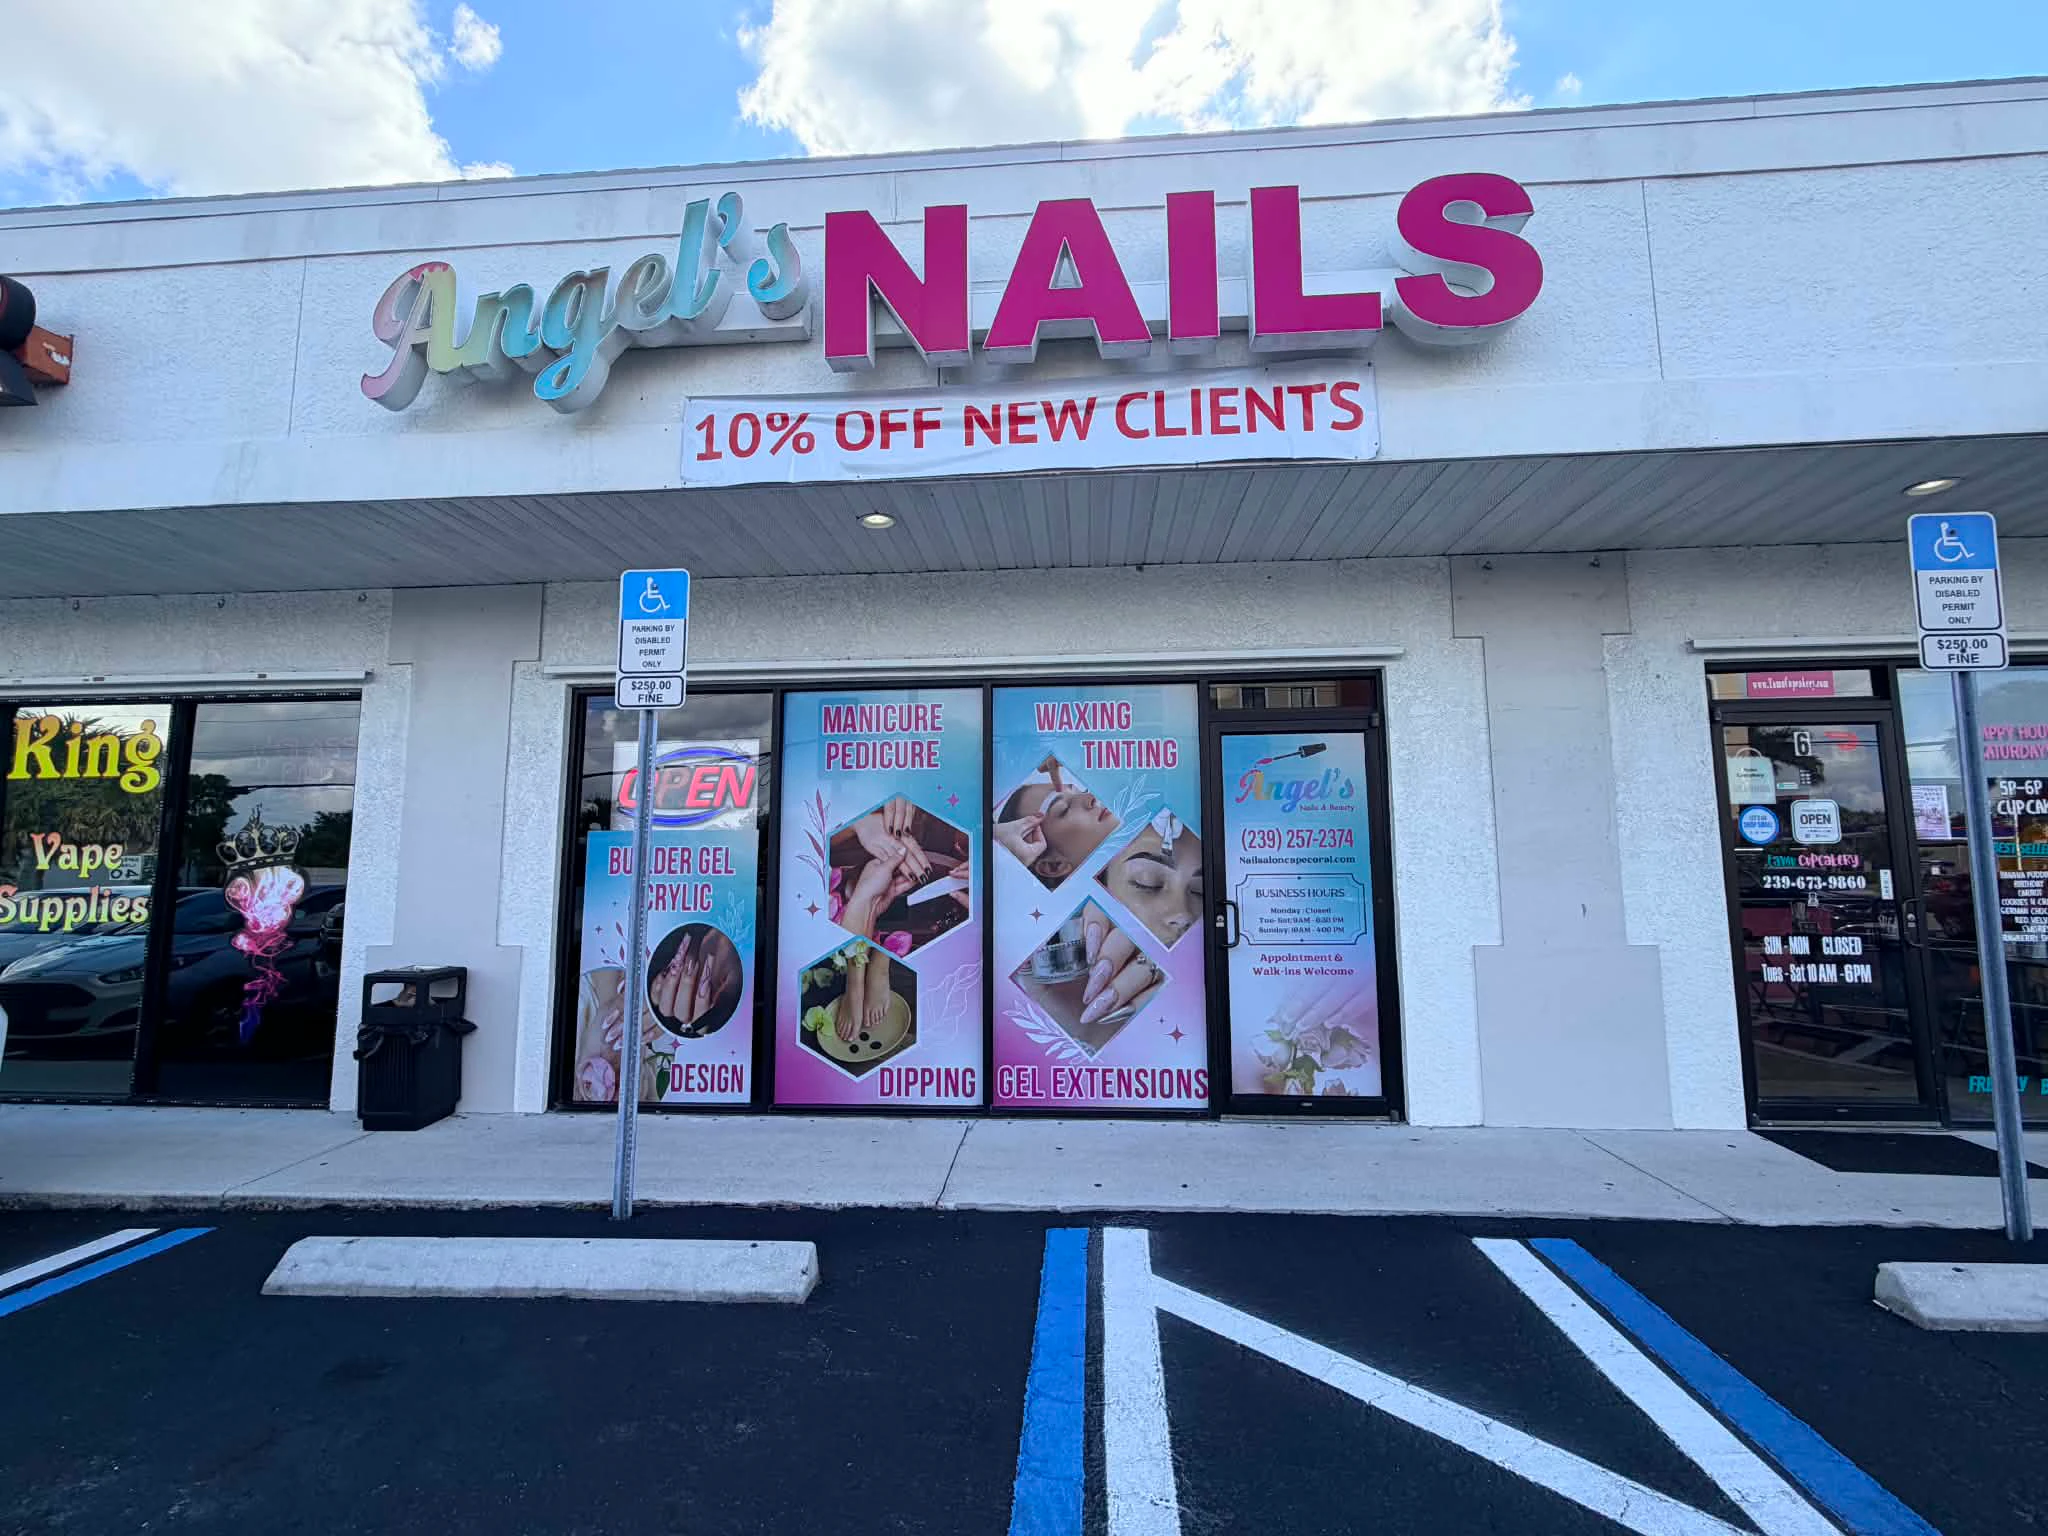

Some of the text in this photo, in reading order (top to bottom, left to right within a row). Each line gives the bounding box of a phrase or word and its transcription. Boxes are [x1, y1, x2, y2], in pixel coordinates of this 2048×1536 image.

[360, 172, 1544, 401] Angel's NAILS
[695, 381, 1364, 461] 10% OFF NEW CLIENTS
[1929, 575, 1984, 585] PARKING BY
[1935, 589, 1980, 598] DISABLED
[1942, 602, 1976, 611] PERMIT
[632, 624, 675, 634] PARKING BY
[1948, 616, 1972, 625] ONLY
[634, 636, 671, 644] DISABLED
[1937, 638, 1988, 650] $250.00
[639, 648, 666, 657] PERMIT
[1948, 653, 1980, 664] FINE
[631, 680, 672, 691] $250.00
[638, 693, 663, 703] FINE
[822, 702, 945, 736] MANICURE
[1035, 701, 1132, 732] WAXING
[1983, 726, 2014, 741] APPY
[7, 714, 164, 793] King
[1081, 738, 1179, 769] TINTING
[1796, 732, 1810, 756] 6
[825, 740, 942, 771] PEDICURE
[618, 765, 756, 808] OPEN
[1235, 767, 1355, 813] Angel's
[1800, 813, 1832, 825] OPEN
[1241, 827, 1355, 852] (239) 257-2374
[30, 832, 124, 878] Vape
[608, 846, 737, 876] BUDER GEL
[1239, 855, 1356, 866] Nailsaloncapecoral.com
[1763, 875, 1866, 890] 239-673-9860
[647, 882, 713, 912] CRYLIC
[1255, 888, 1345, 898] BUSINESS HOURS
[0, 883, 150, 932] Supplies
[1270, 907, 1300, 915] Monday
[1763, 935, 1783, 955] SUN
[1788, 935, 1810, 955] MON
[1822, 936, 1863, 955] CLOSED
[1260, 953, 1344, 964] Appointment &
[1252, 966, 1355, 976] Walk-ins Welcome
[1761, 963, 1784, 982] Tues
[1789, 963, 1806, 982] Sat
[671, 1062, 744, 1093] DESIGN
[878, 1066, 976, 1098] DIPPING
[998, 1065, 1210, 1100] GEL EXTENSIONS
